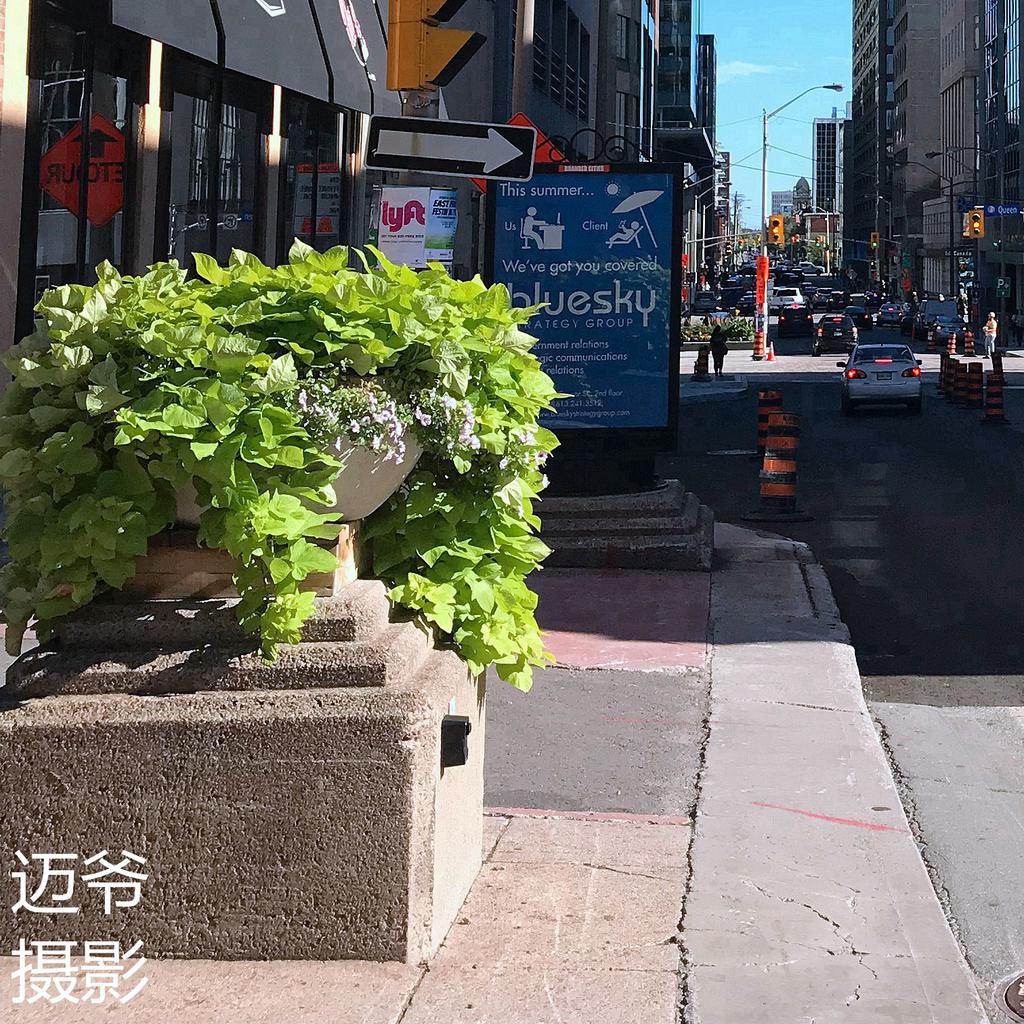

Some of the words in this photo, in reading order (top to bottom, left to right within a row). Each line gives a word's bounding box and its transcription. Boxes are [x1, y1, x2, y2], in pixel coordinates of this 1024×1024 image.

[500, 183, 526, 197] This
[530, 185, 594, 197] summer...
[998, 206, 1017, 214] Queen
[382, 200, 426, 233] lyft
[505, 221, 517, 231] Us
[583, 220, 609, 231] Client
[502, 259, 546, 273] We've
[550, 260, 572, 276] got
[576, 262, 600, 276] you
[605, 256, 657, 272] covered
[508, 279, 655, 327] bluesky
[524, 319, 579, 329] RATEGY
[585, 318, 633, 328] GROUP
[533, 341, 568, 350] ernment
[571, 338, 609, 350] relations
[556, 351, 628, 362] communications
[546, 365, 584, 375] relations
[608, 388, 623, 397] floor
